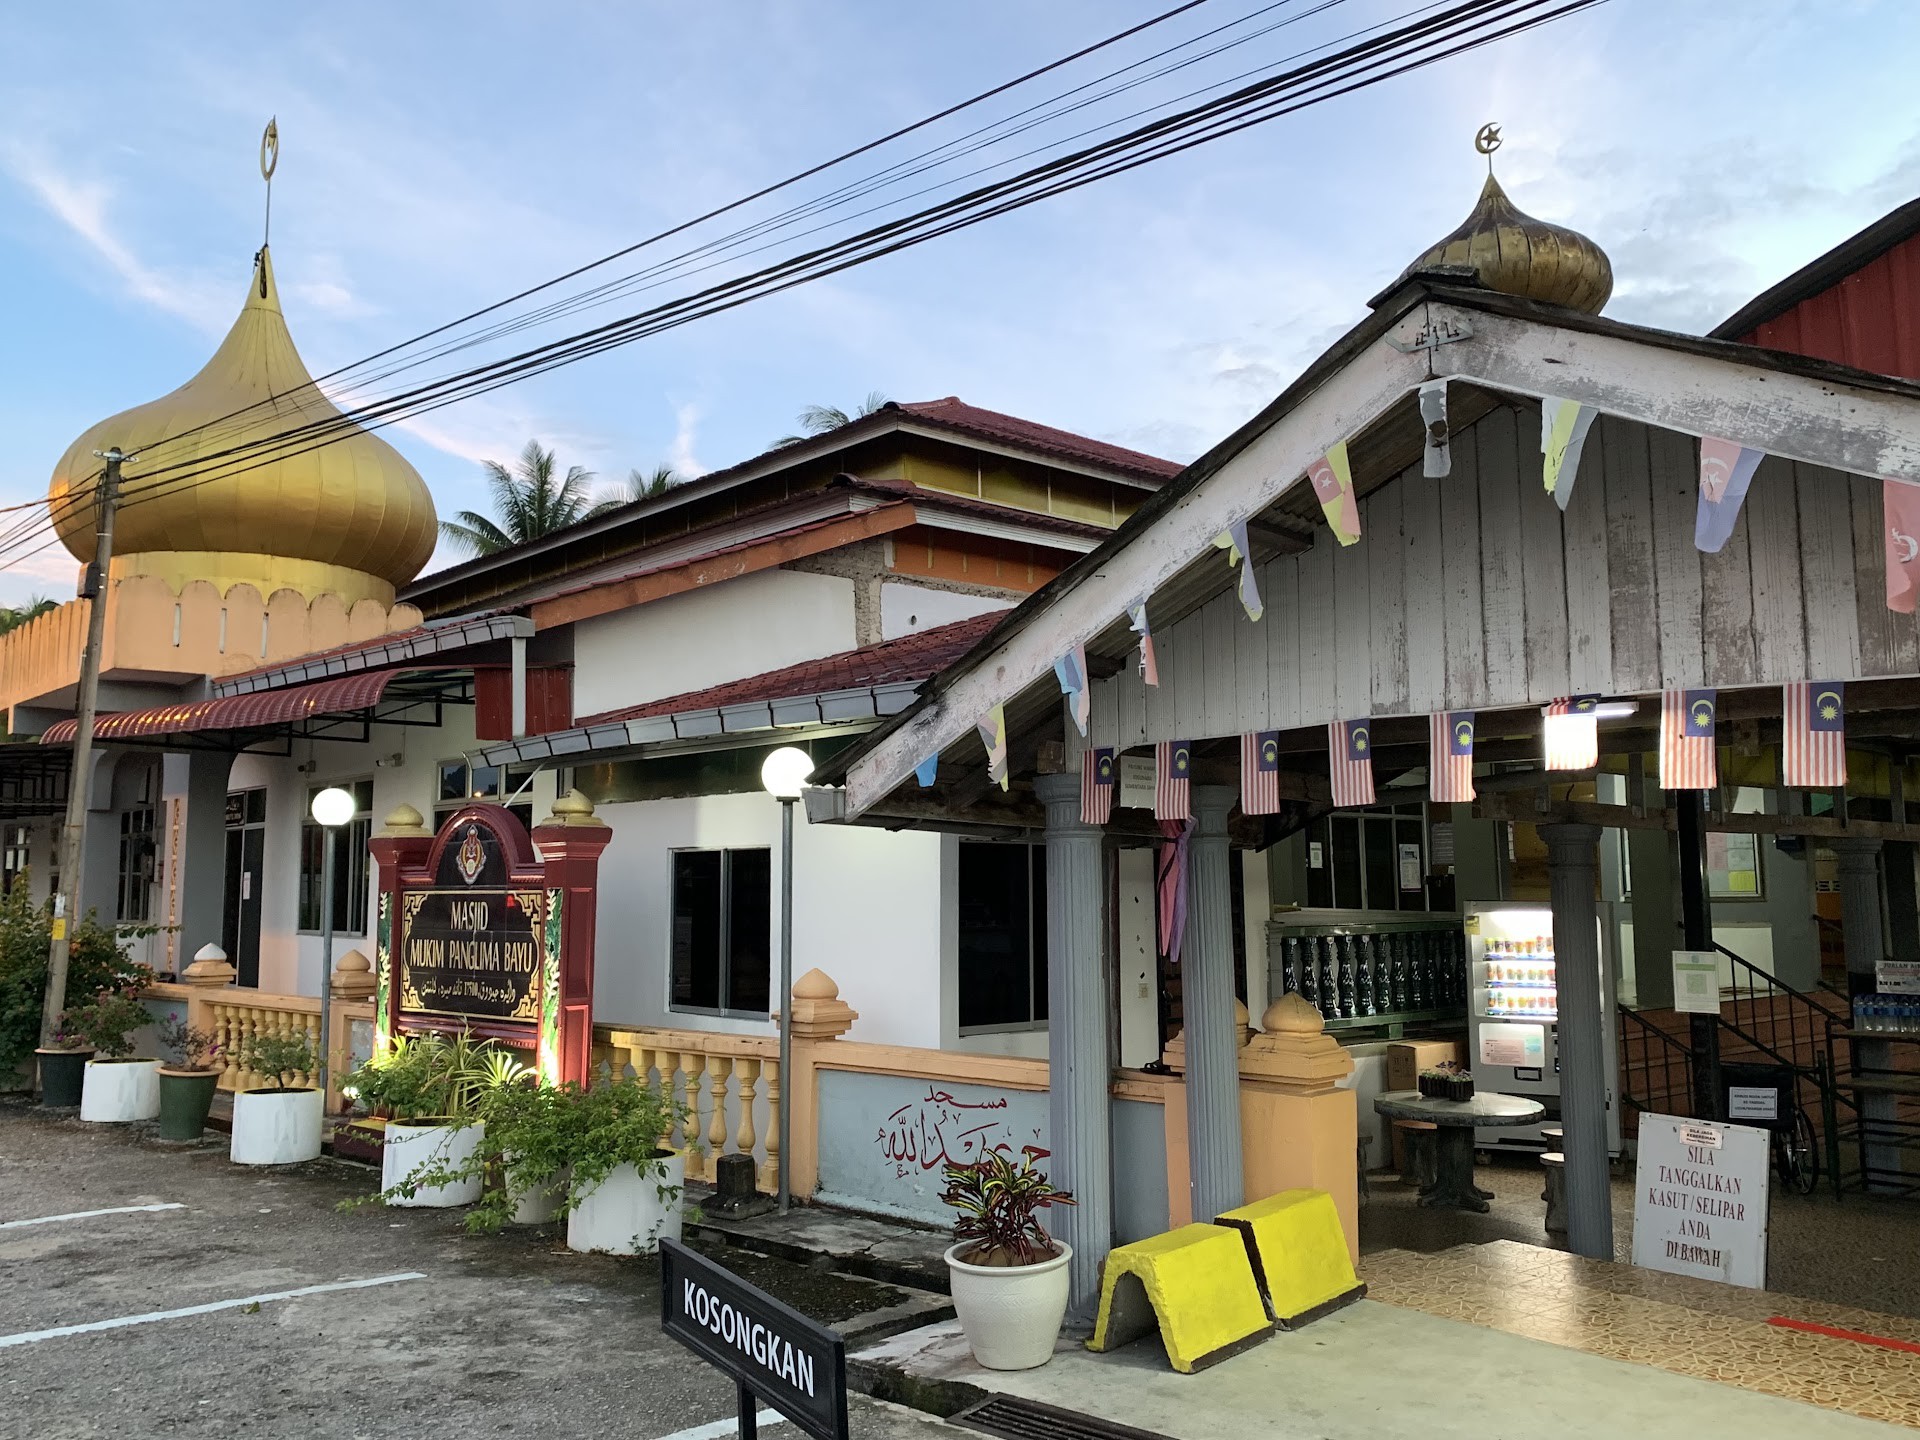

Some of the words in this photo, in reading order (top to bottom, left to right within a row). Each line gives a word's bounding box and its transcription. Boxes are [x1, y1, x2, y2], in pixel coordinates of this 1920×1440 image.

[450, 901, 488, 931] MASJID
[410, 939, 444, 968] MUKIM
[449, 940, 500, 971] PANGLIMA
[504, 942, 533, 973] BAYU
[923, 1084, 1008, 1109] مسجد
[1687, 1146, 1715, 1166] SILA
[1659, 1165, 1742, 1195] TANGGALKAN
[1678, 1218, 1711, 1241] ANDA
[684, 1277, 814, 1398] KOSONGKAN
